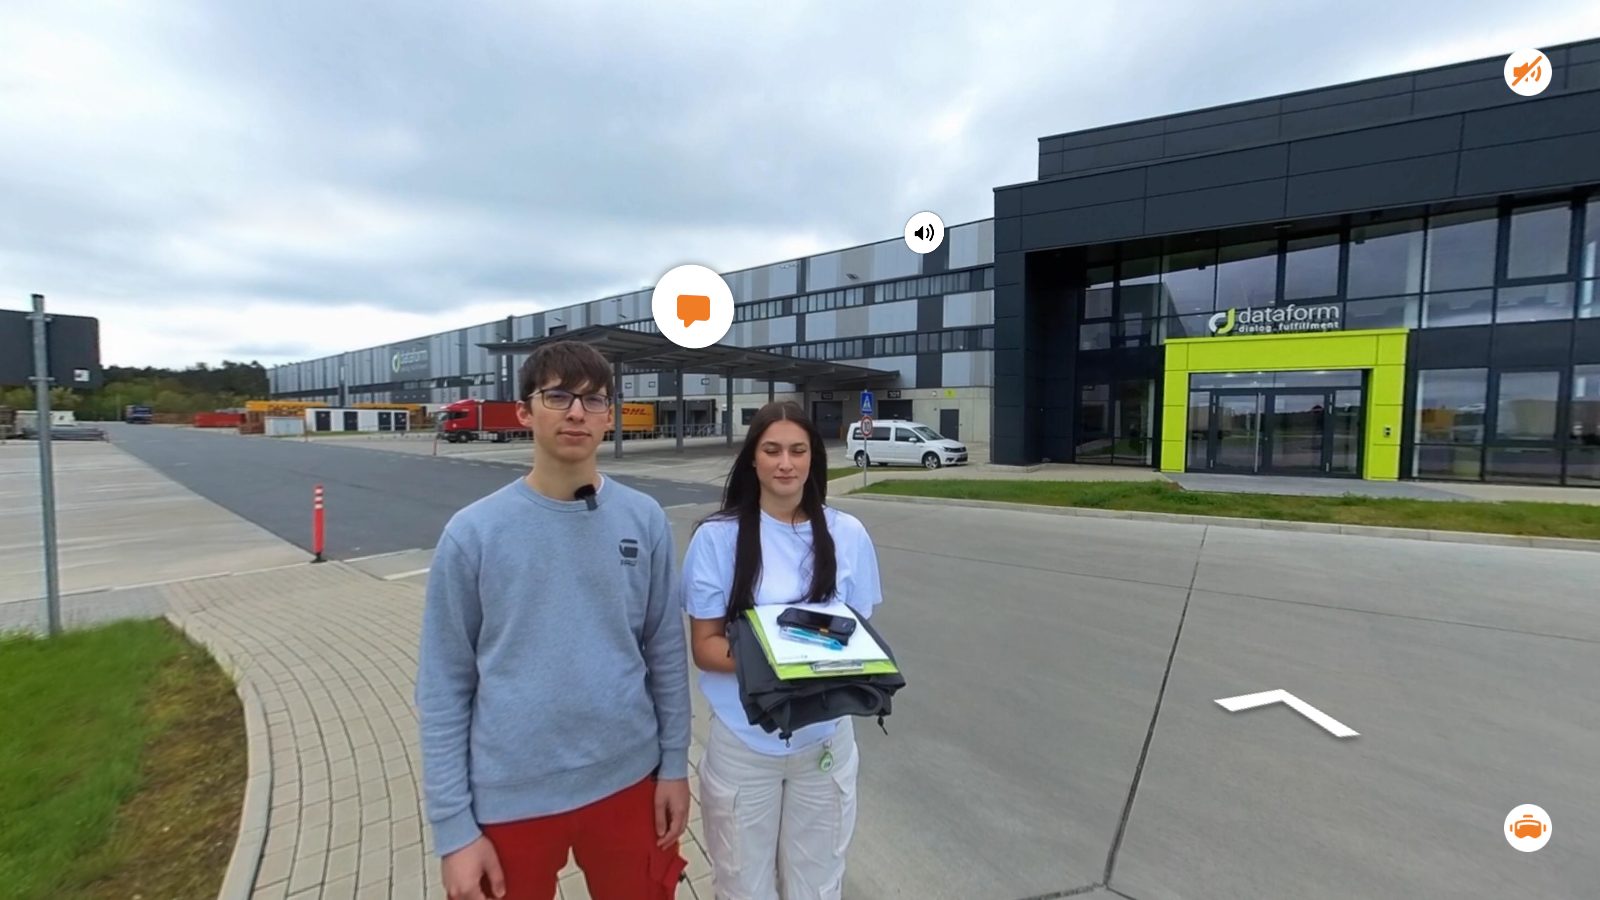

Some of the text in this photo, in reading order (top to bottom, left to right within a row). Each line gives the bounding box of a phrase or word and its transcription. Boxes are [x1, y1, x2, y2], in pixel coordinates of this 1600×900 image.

[1238, 304, 1339, 324] dataform
[1279, 321, 1339, 331] fulfillment
[622, 407, 647, 416] DHL
